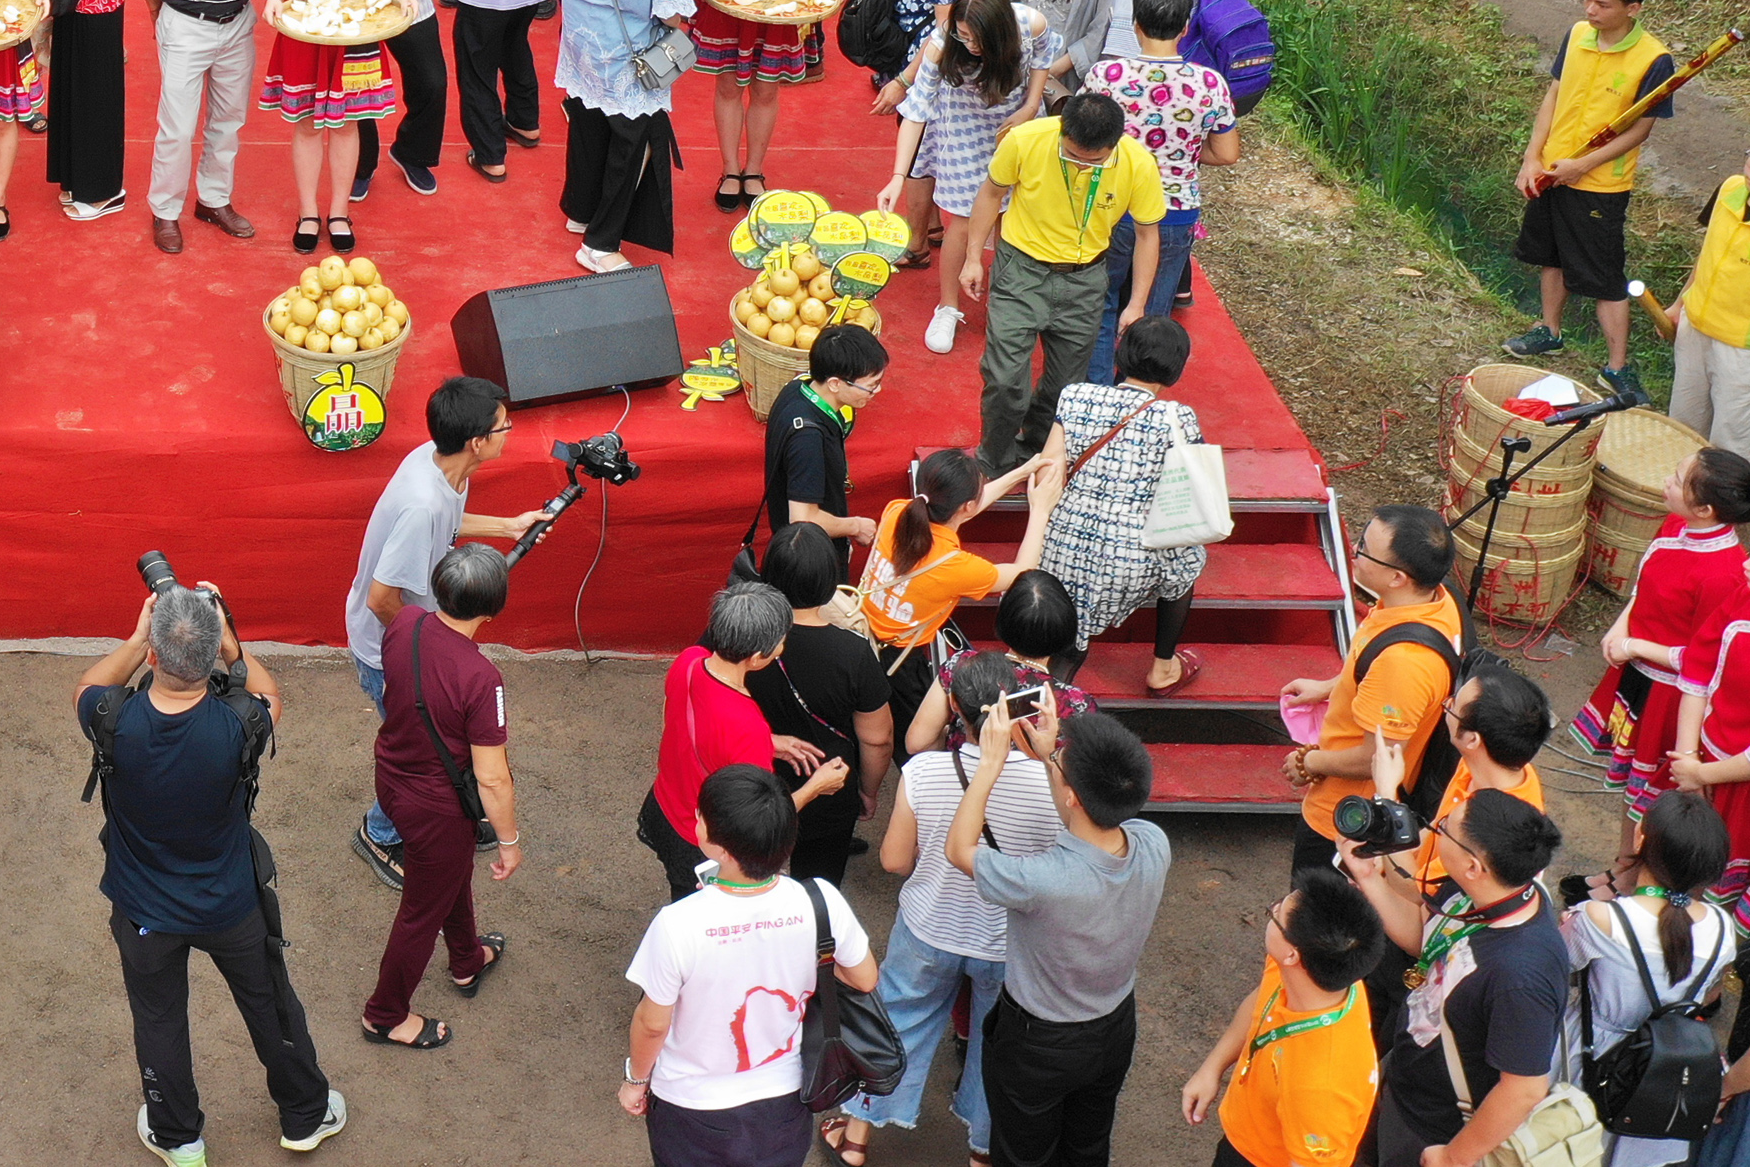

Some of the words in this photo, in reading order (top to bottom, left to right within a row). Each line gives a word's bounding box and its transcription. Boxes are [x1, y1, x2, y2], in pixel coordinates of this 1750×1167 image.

[326, 394, 362, 433] 晶
[706, 923, 751, 938] 中国平安
